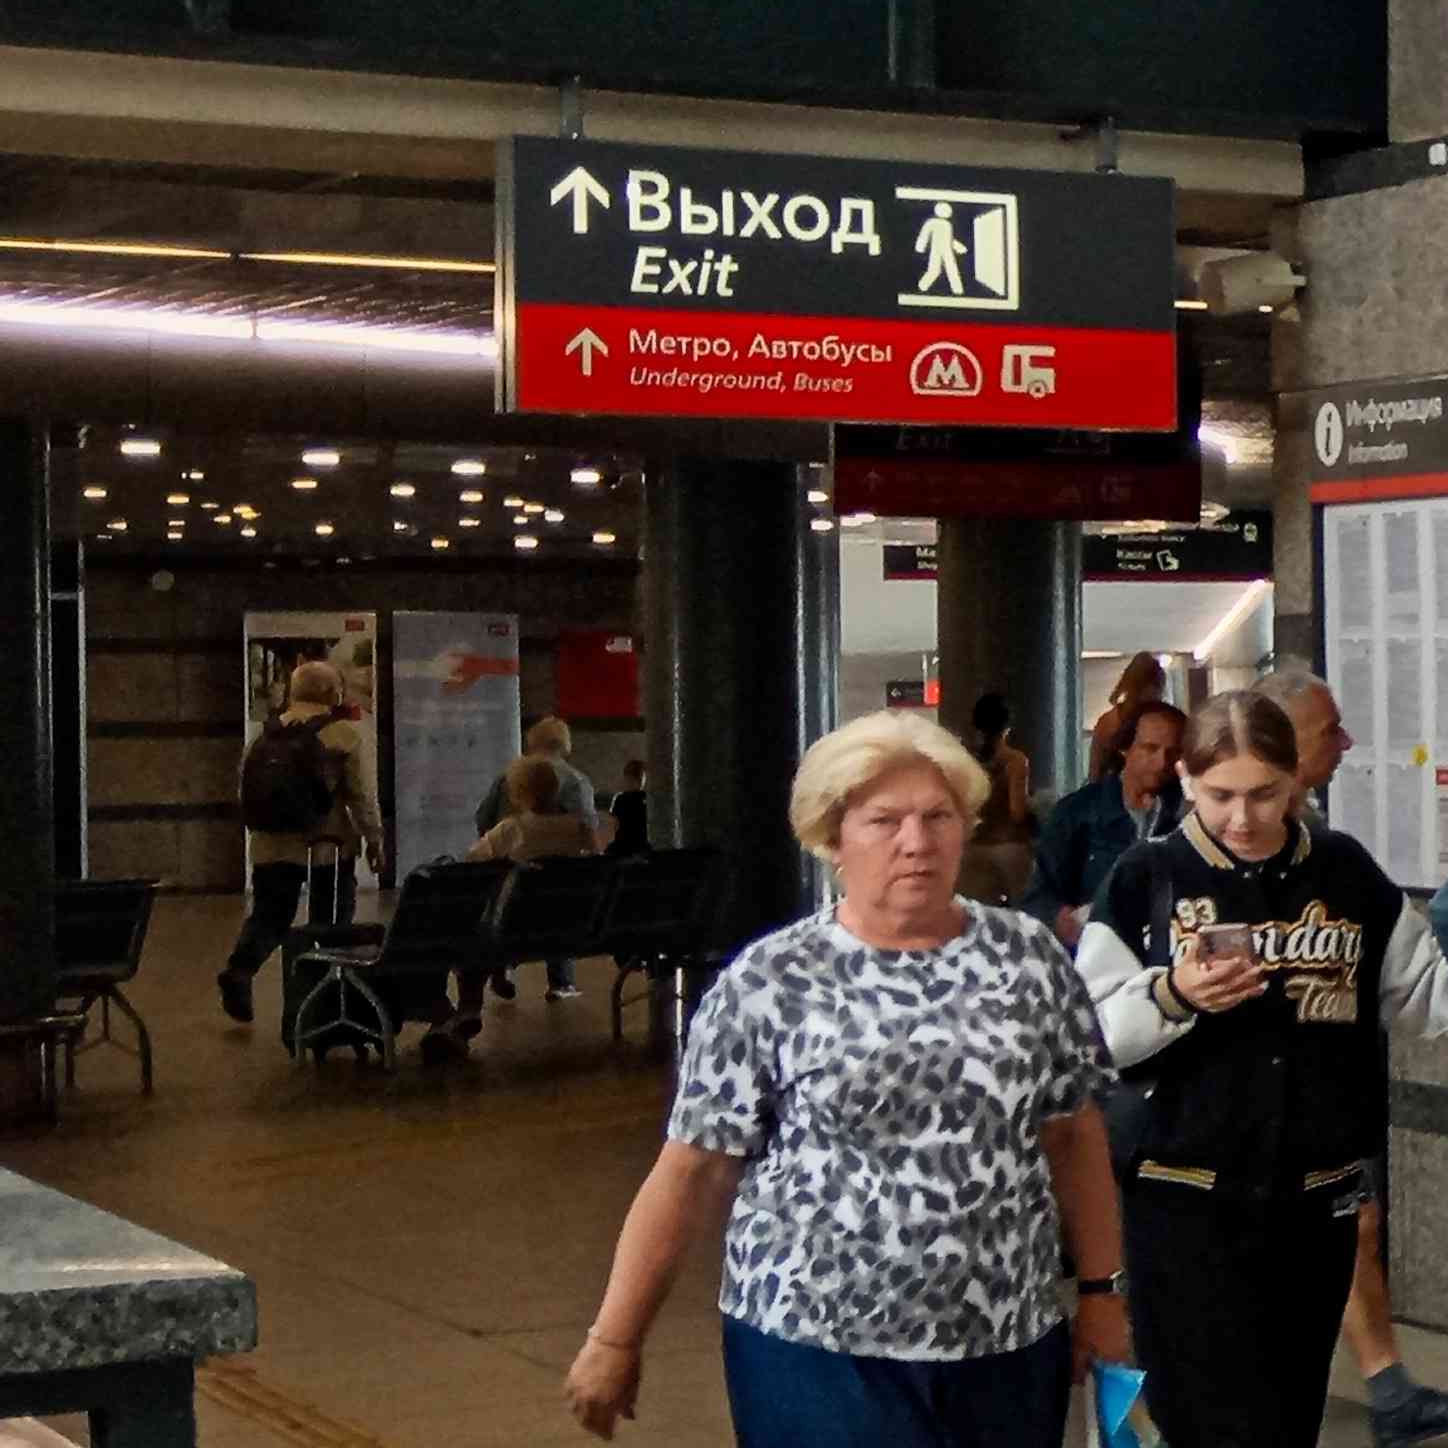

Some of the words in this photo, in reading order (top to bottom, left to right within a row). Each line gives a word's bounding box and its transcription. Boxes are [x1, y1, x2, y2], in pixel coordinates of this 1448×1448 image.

[626, 169, 881, 256] Выход
[630, 246, 739, 297] Exit
[629, 328, 740, 362] Метро,
[748, 333, 892, 366] Автобусы
[630, 367, 787, 393] Underground,
[794, 375, 853, 393] Buses
